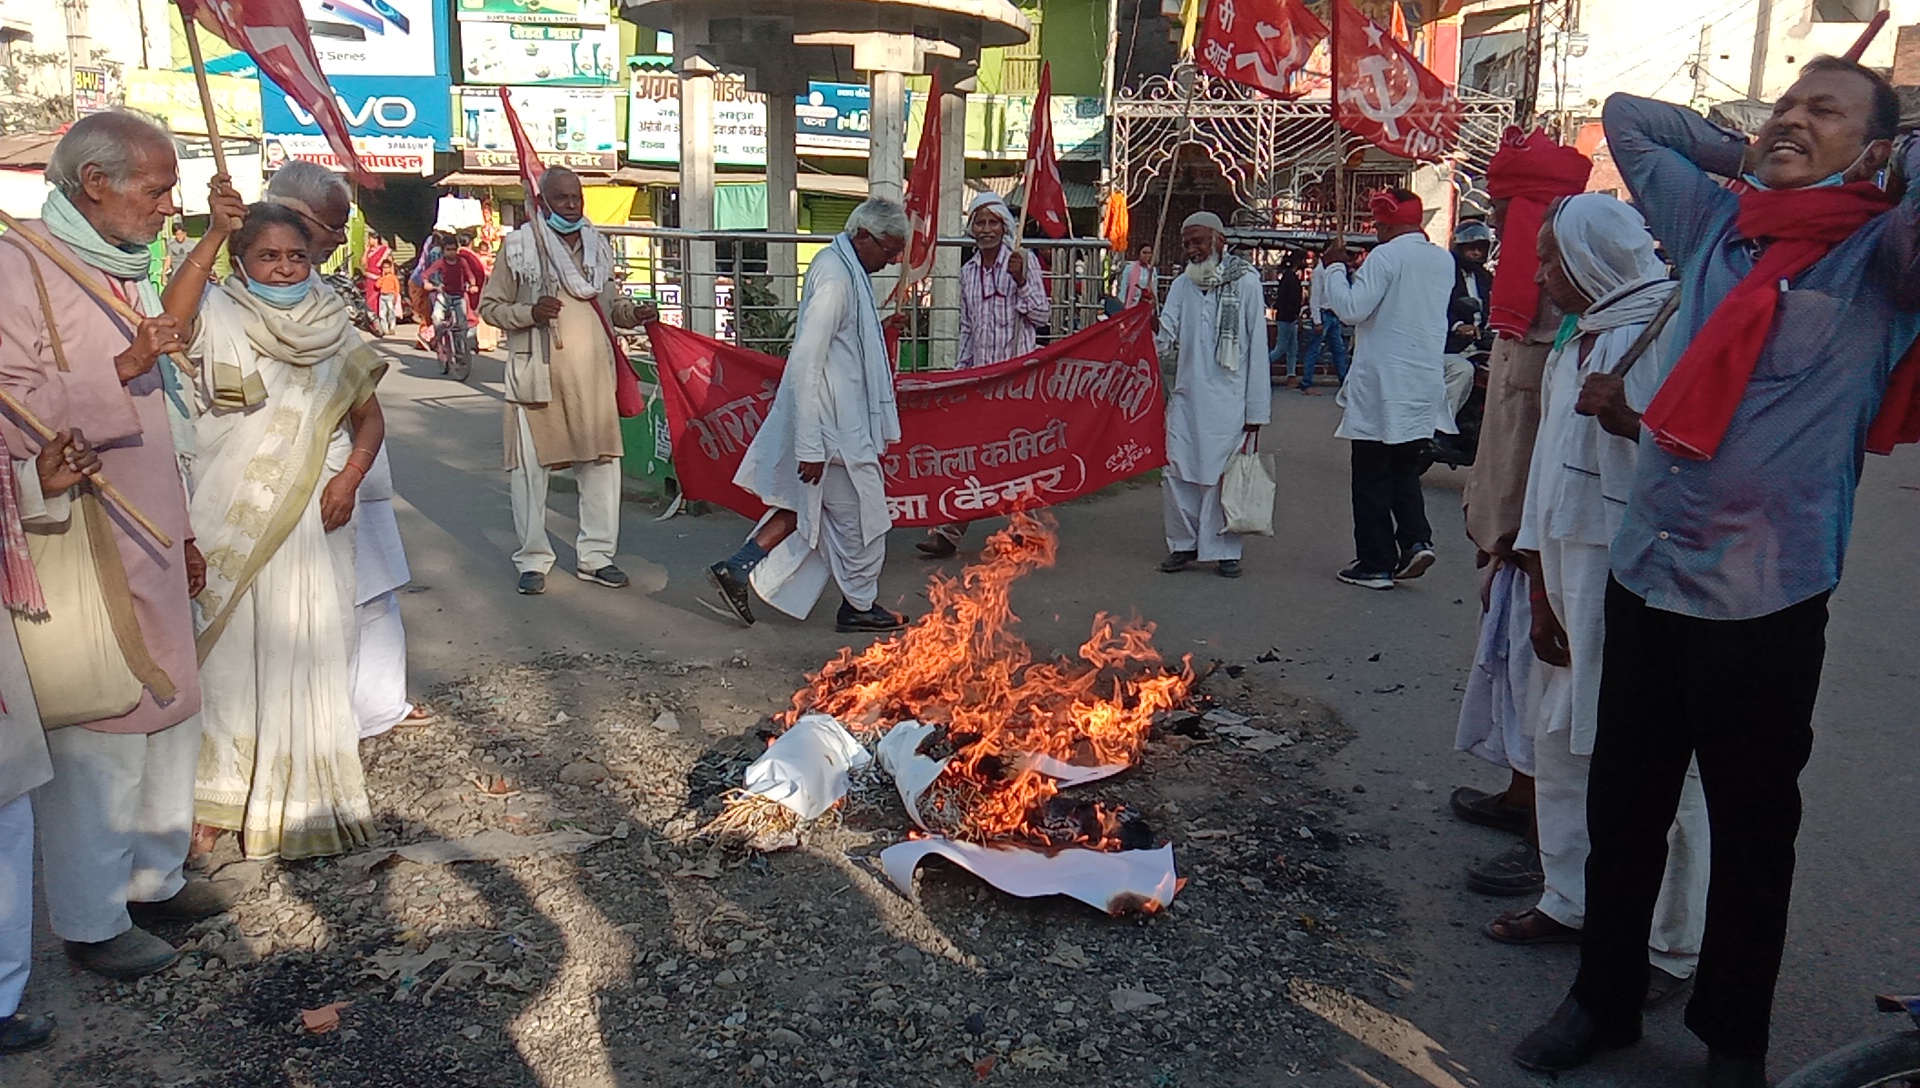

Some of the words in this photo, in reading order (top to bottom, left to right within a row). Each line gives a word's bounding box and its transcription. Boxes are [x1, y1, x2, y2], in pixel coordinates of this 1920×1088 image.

[1219, 0, 1236, 33] पी
[327, 51, 366, 61] Series
[1204, 38, 1235, 77] आई
[284, 86, 416, 128] vvo
[906, 444, 978, 479] जिला
[981, 418, 1068, 468] कमिटी
